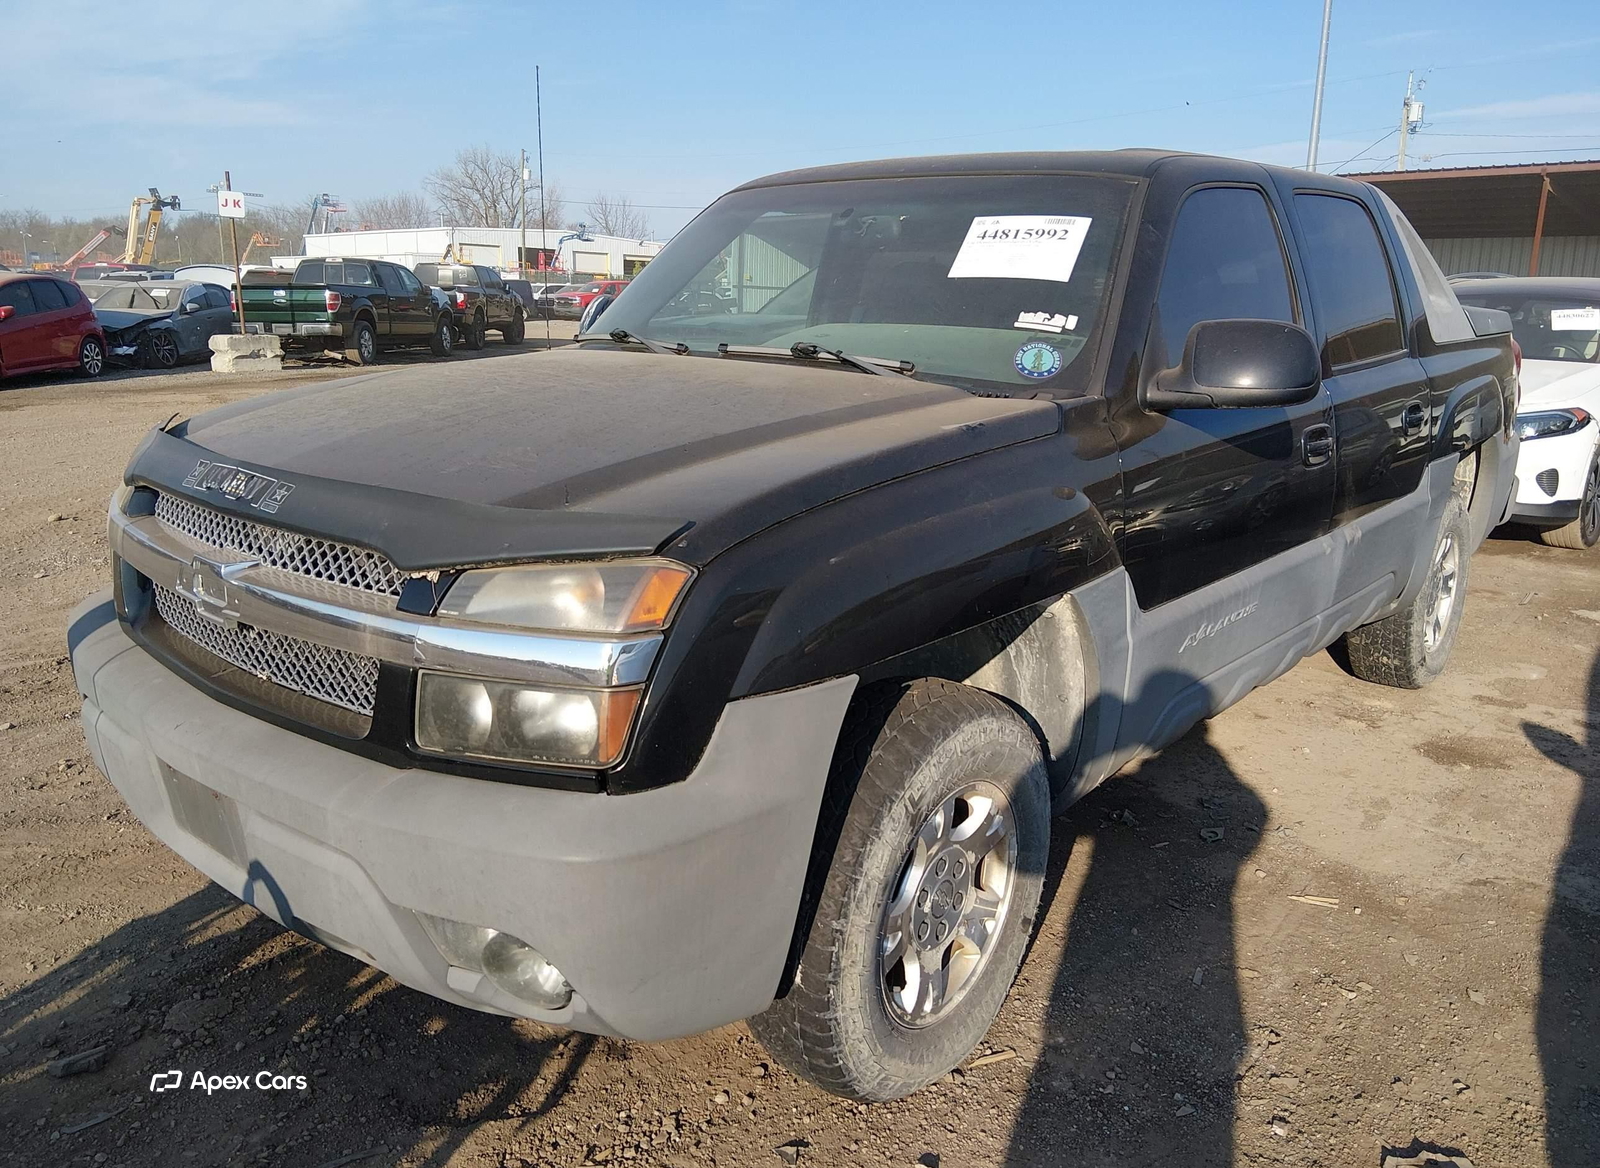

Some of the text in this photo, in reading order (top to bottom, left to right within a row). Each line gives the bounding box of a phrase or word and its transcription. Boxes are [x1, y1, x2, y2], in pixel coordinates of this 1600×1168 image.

[221, 198, 242, 208] J K
[976, 228, 1069, 241] 44815992
[1022, 343, 1054, 352] NATIONAL
